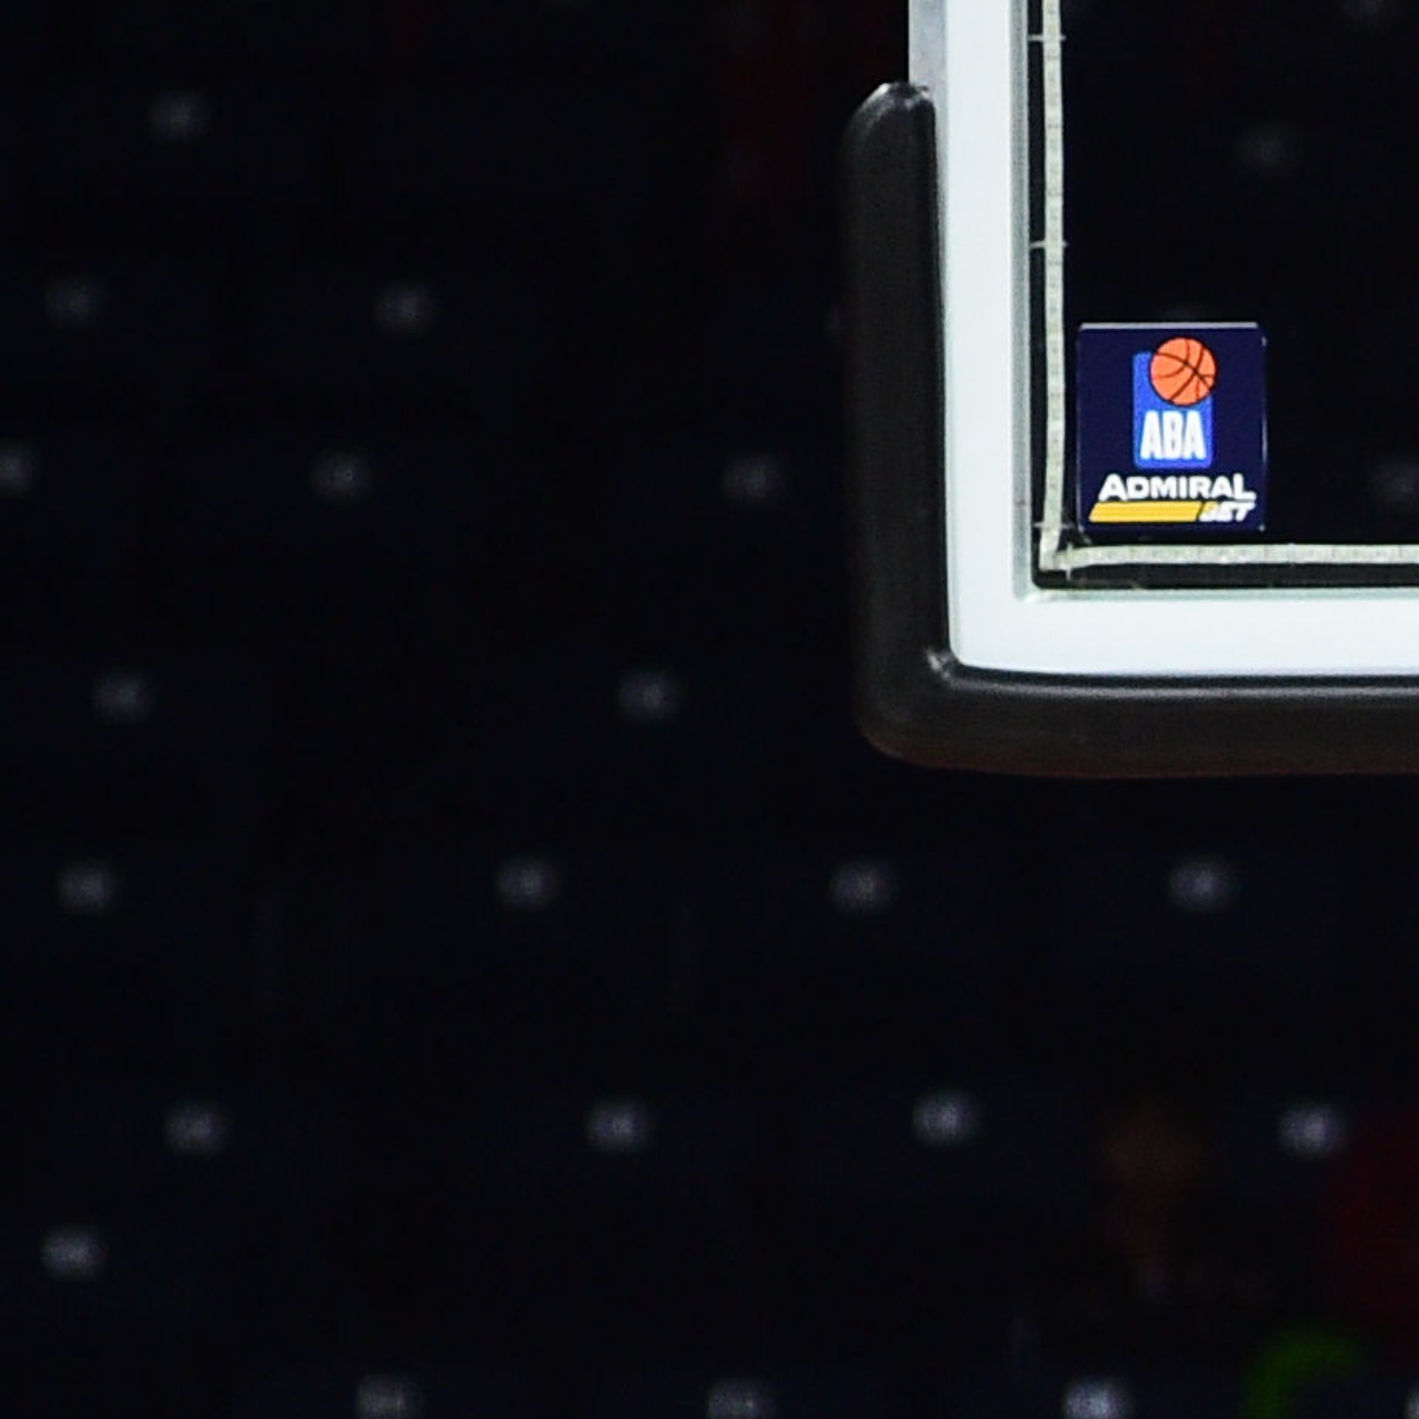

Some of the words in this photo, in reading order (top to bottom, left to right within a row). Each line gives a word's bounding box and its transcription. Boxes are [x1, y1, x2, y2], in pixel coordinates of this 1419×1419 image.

[1140, 410, 1207, 460] ABA
[1098, 473, 1257, 501] ADMIRAL
[1199, 501, 1256, 523] BET
